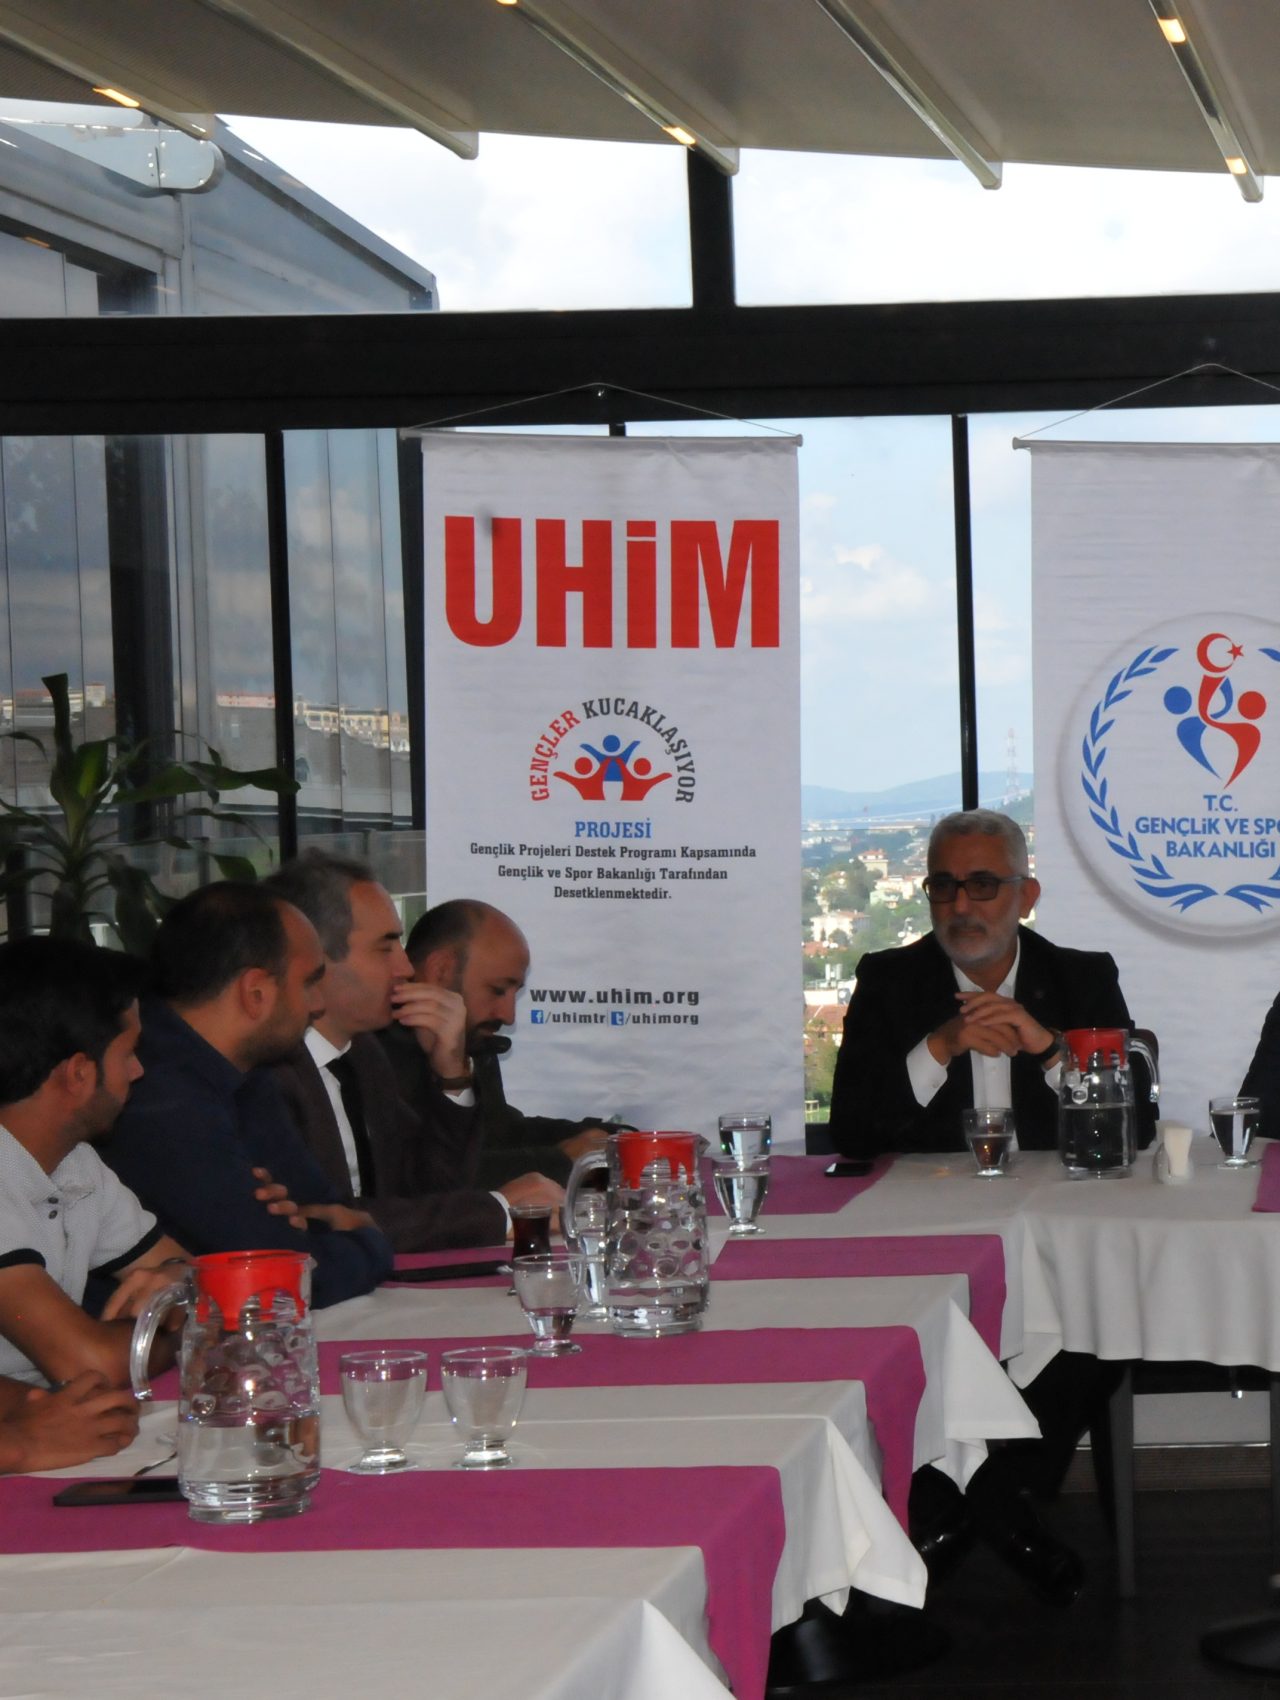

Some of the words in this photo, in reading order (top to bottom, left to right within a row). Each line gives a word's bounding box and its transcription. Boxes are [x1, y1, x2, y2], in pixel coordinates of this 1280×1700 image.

[530, 710, 581, 801] GENÇLER
[582, 698, 696, 803] KUCAKLAŞIYOR
[1203, 794, 1239, 812] T.C.
[575, 818, 652, 838] PROJESİ
[1224, 817, 1249, 835] VE
[470, 842, 516, 859] Gençlik
[519, 844, 571, 859] Projeleri
[575, 845, 616, 858] Destek
[620, 846, 677, 860] Programı
[680, 846, 757, 860] Kapsamında
[1166, 838, 1276, 859] BAKANLIĞI
[498, 865, 544, 880] Gençlik
[548, 869, 561, 878] ve
[565, 867, 593, 881] Spor
[597, 867, 656, 882] Bakanlığı
[659, 867, 728, 879] Tarafından
[554, 886, 672, 899] Desetklenmektedir.
[530, 988, 699, 1006] www.uhim.org
